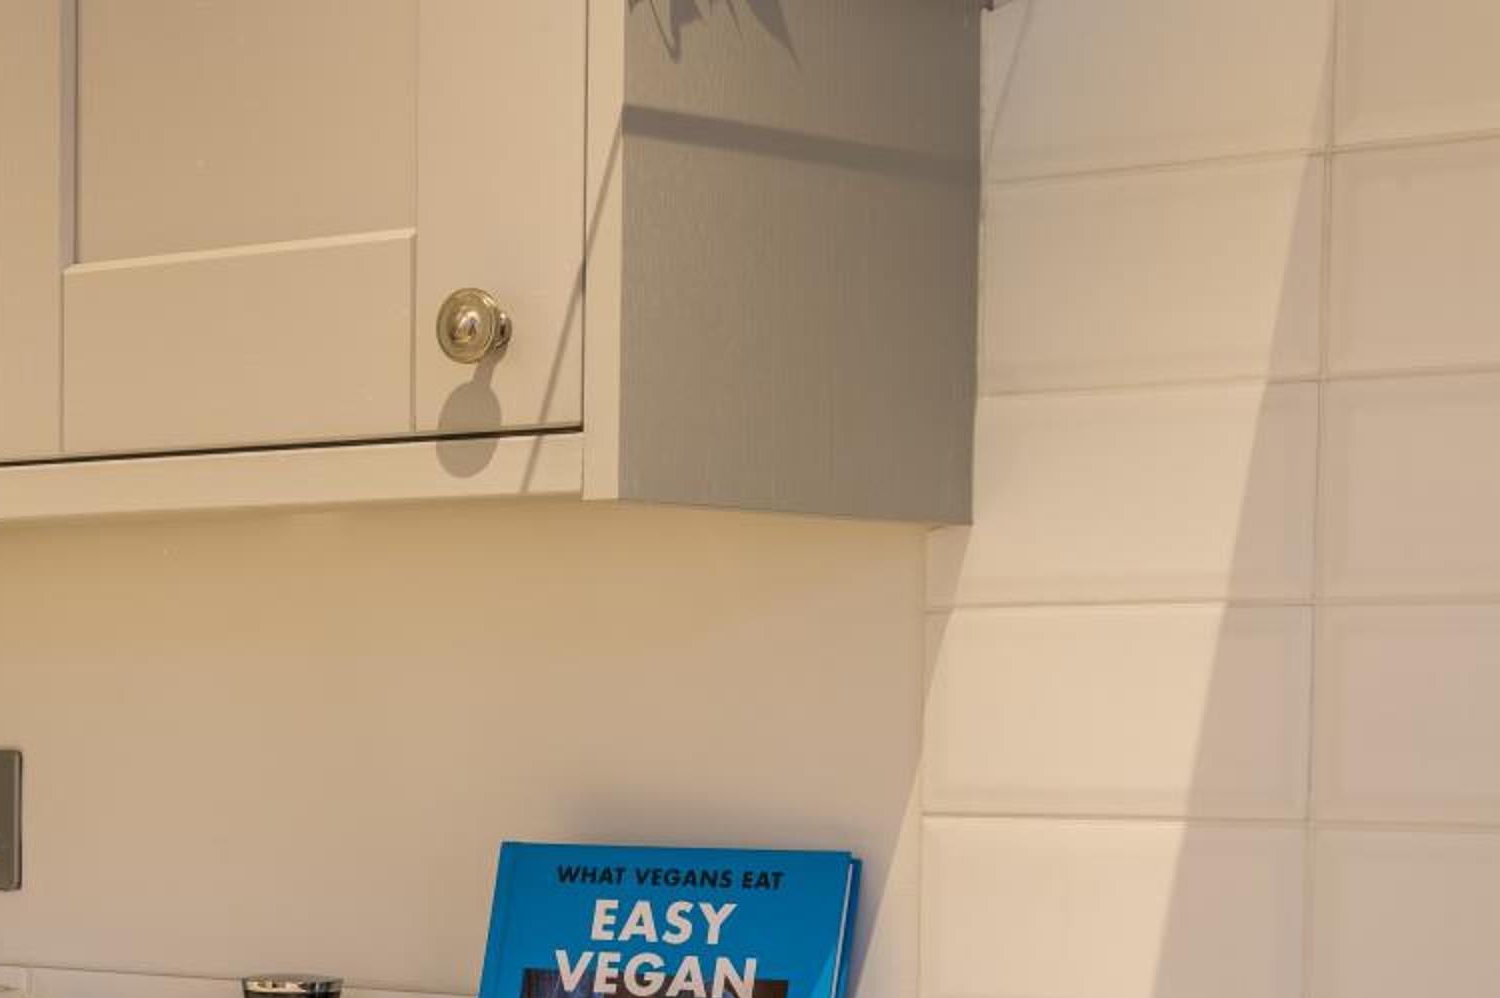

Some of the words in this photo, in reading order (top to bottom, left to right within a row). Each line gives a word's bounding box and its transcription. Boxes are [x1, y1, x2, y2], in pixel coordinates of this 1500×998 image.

[557, 865, 626, 884] WHAT
[635, 867, 733, 889] VEGANS
[741, 870, 784, 890] EAT
[591, 899, 738, 945] EASY
